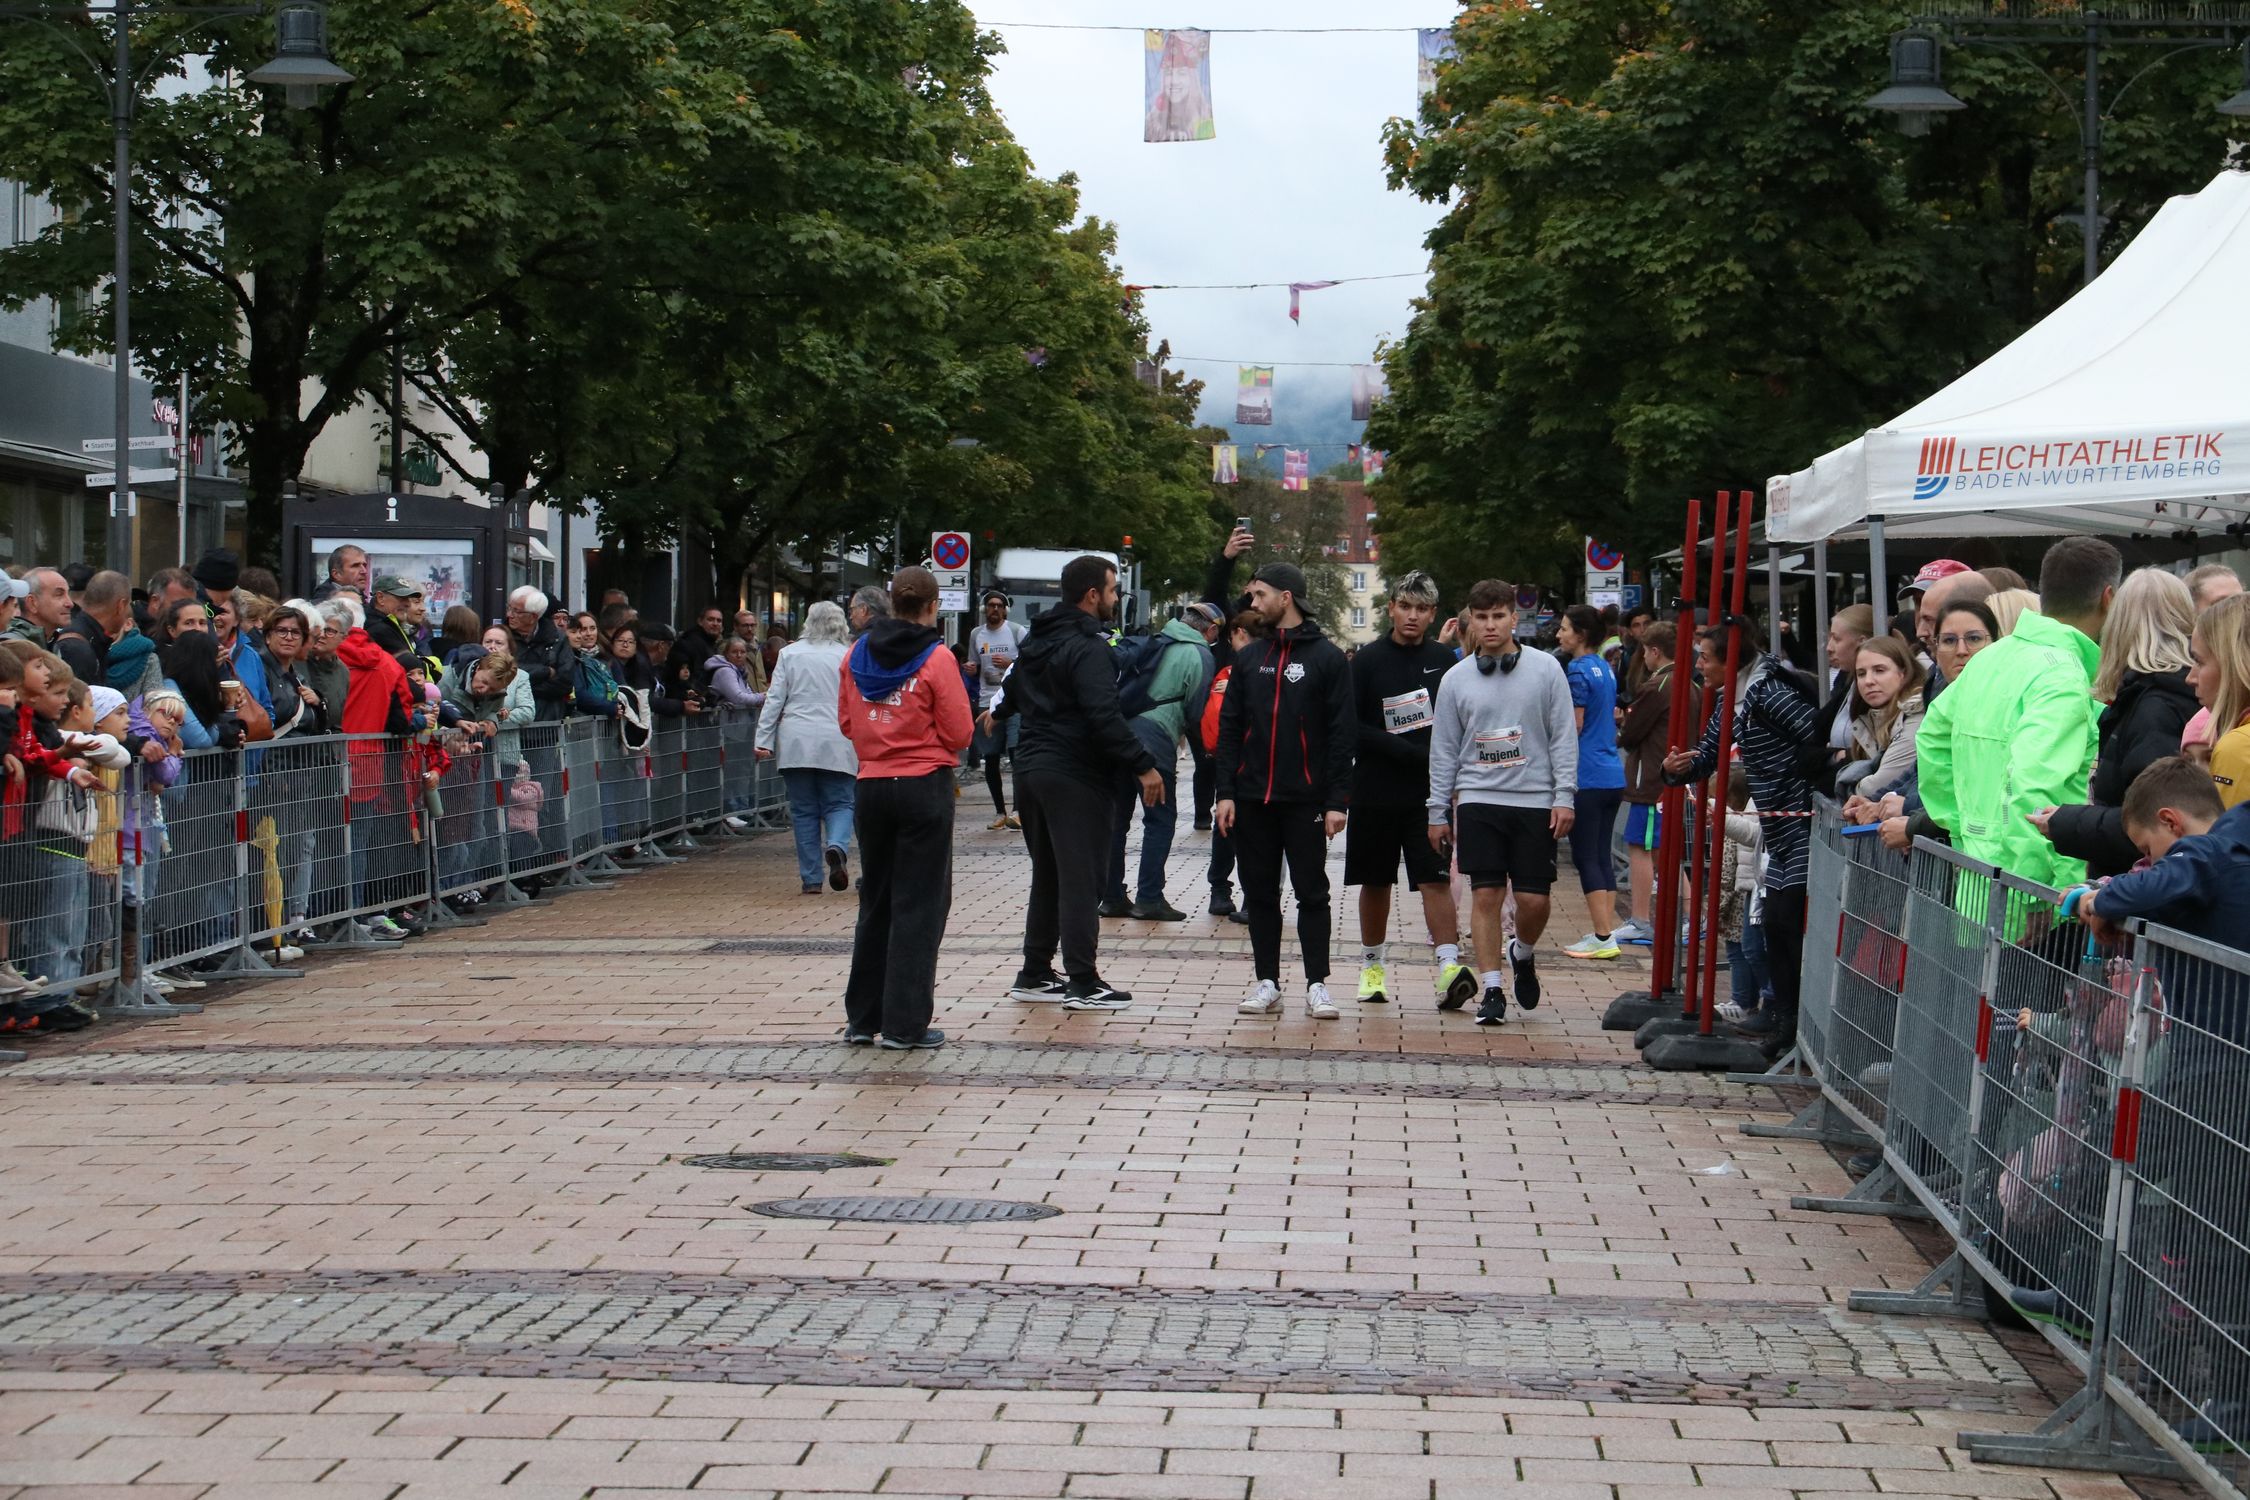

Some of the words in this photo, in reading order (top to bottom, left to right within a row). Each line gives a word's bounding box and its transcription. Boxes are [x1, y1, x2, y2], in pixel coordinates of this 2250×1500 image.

[1959, 432, 2224, 473] LEICHTATHLETIK
[1955, 460, 2221, 491] BADEN-WÜRTTEMBERG
[989, 646, 1009, 654] BITZER
[1393, 711, 1425, 727] Hasan
[1479, 746, 1520, 763] Argjend
